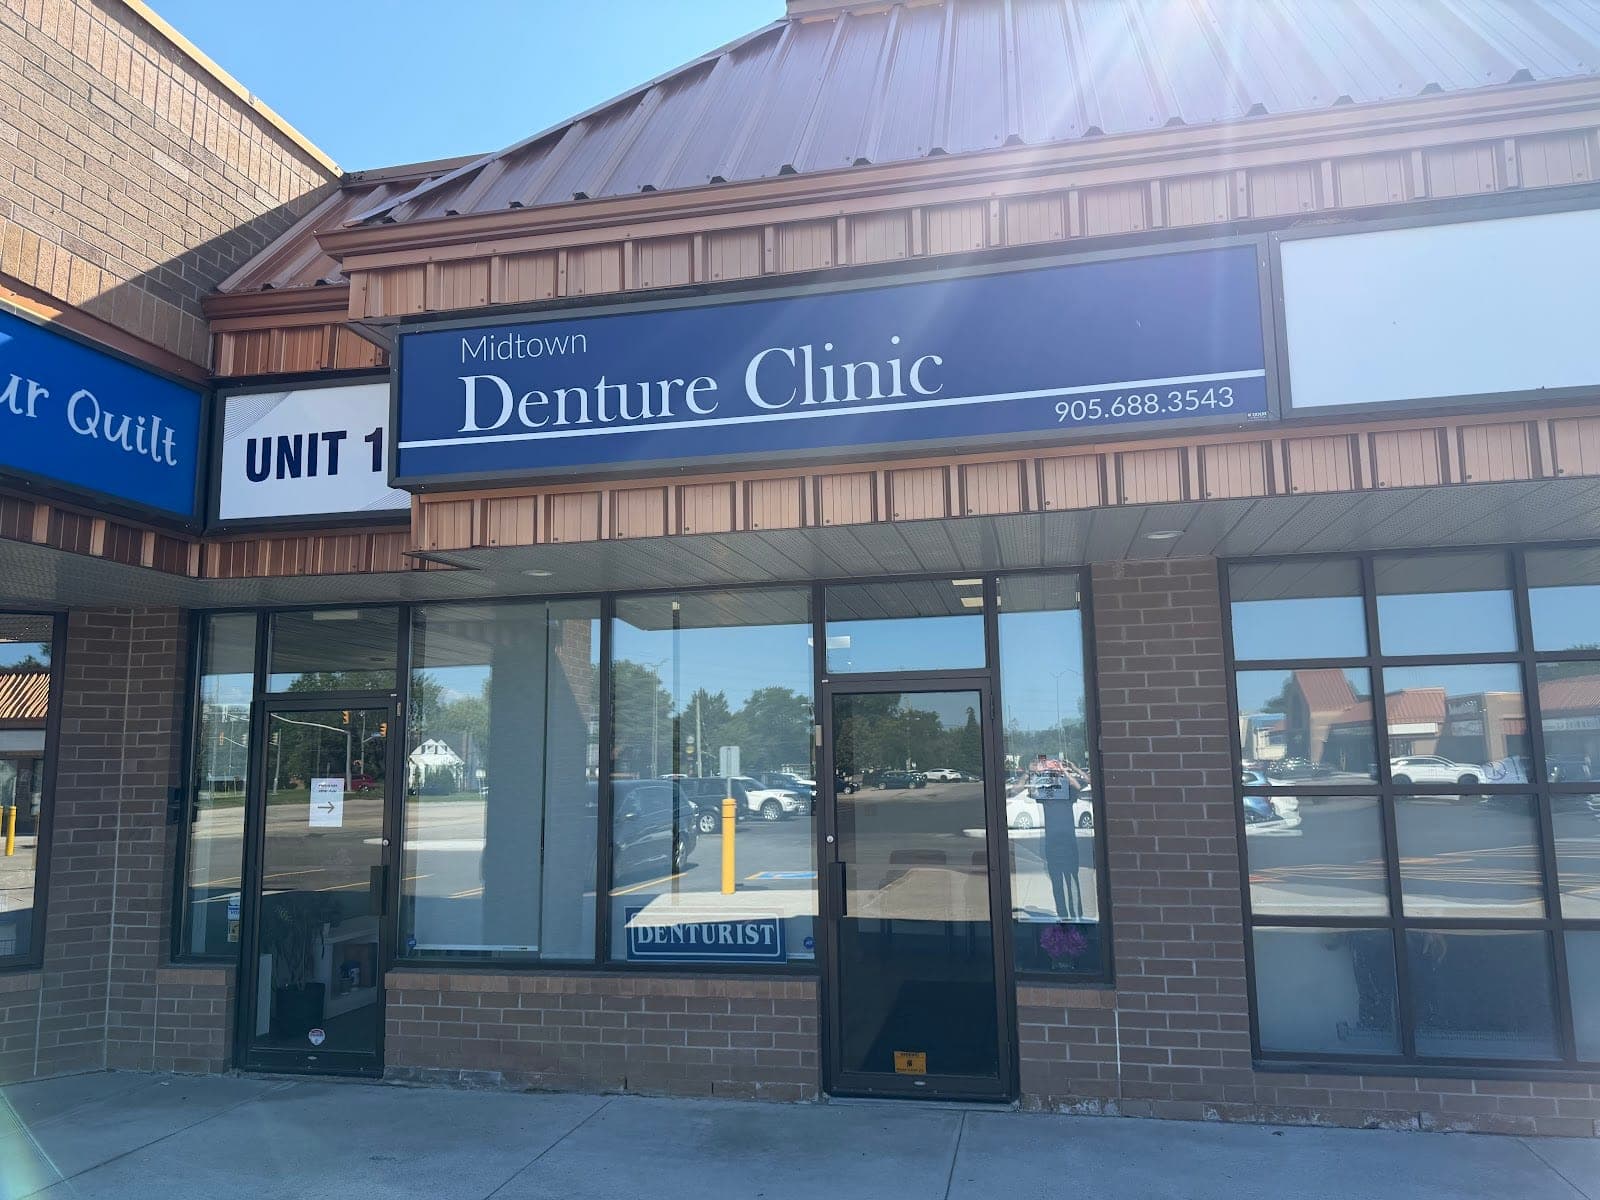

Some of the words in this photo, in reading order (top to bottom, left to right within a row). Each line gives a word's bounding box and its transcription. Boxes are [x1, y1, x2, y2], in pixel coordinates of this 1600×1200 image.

[460, 331, 588, 364] Midtown
[458, 374, 719, 433] Denture
[744, 335, 944, 410] Clinic
[1055, 386, 1235, 423] 905.688.3543
[67, 389, 178, 467] Quilt
[246, 430, 347, 483] UNIT
[364, 427, 384, 472] 1
[637, 923, 775, 945] DENTURIST
